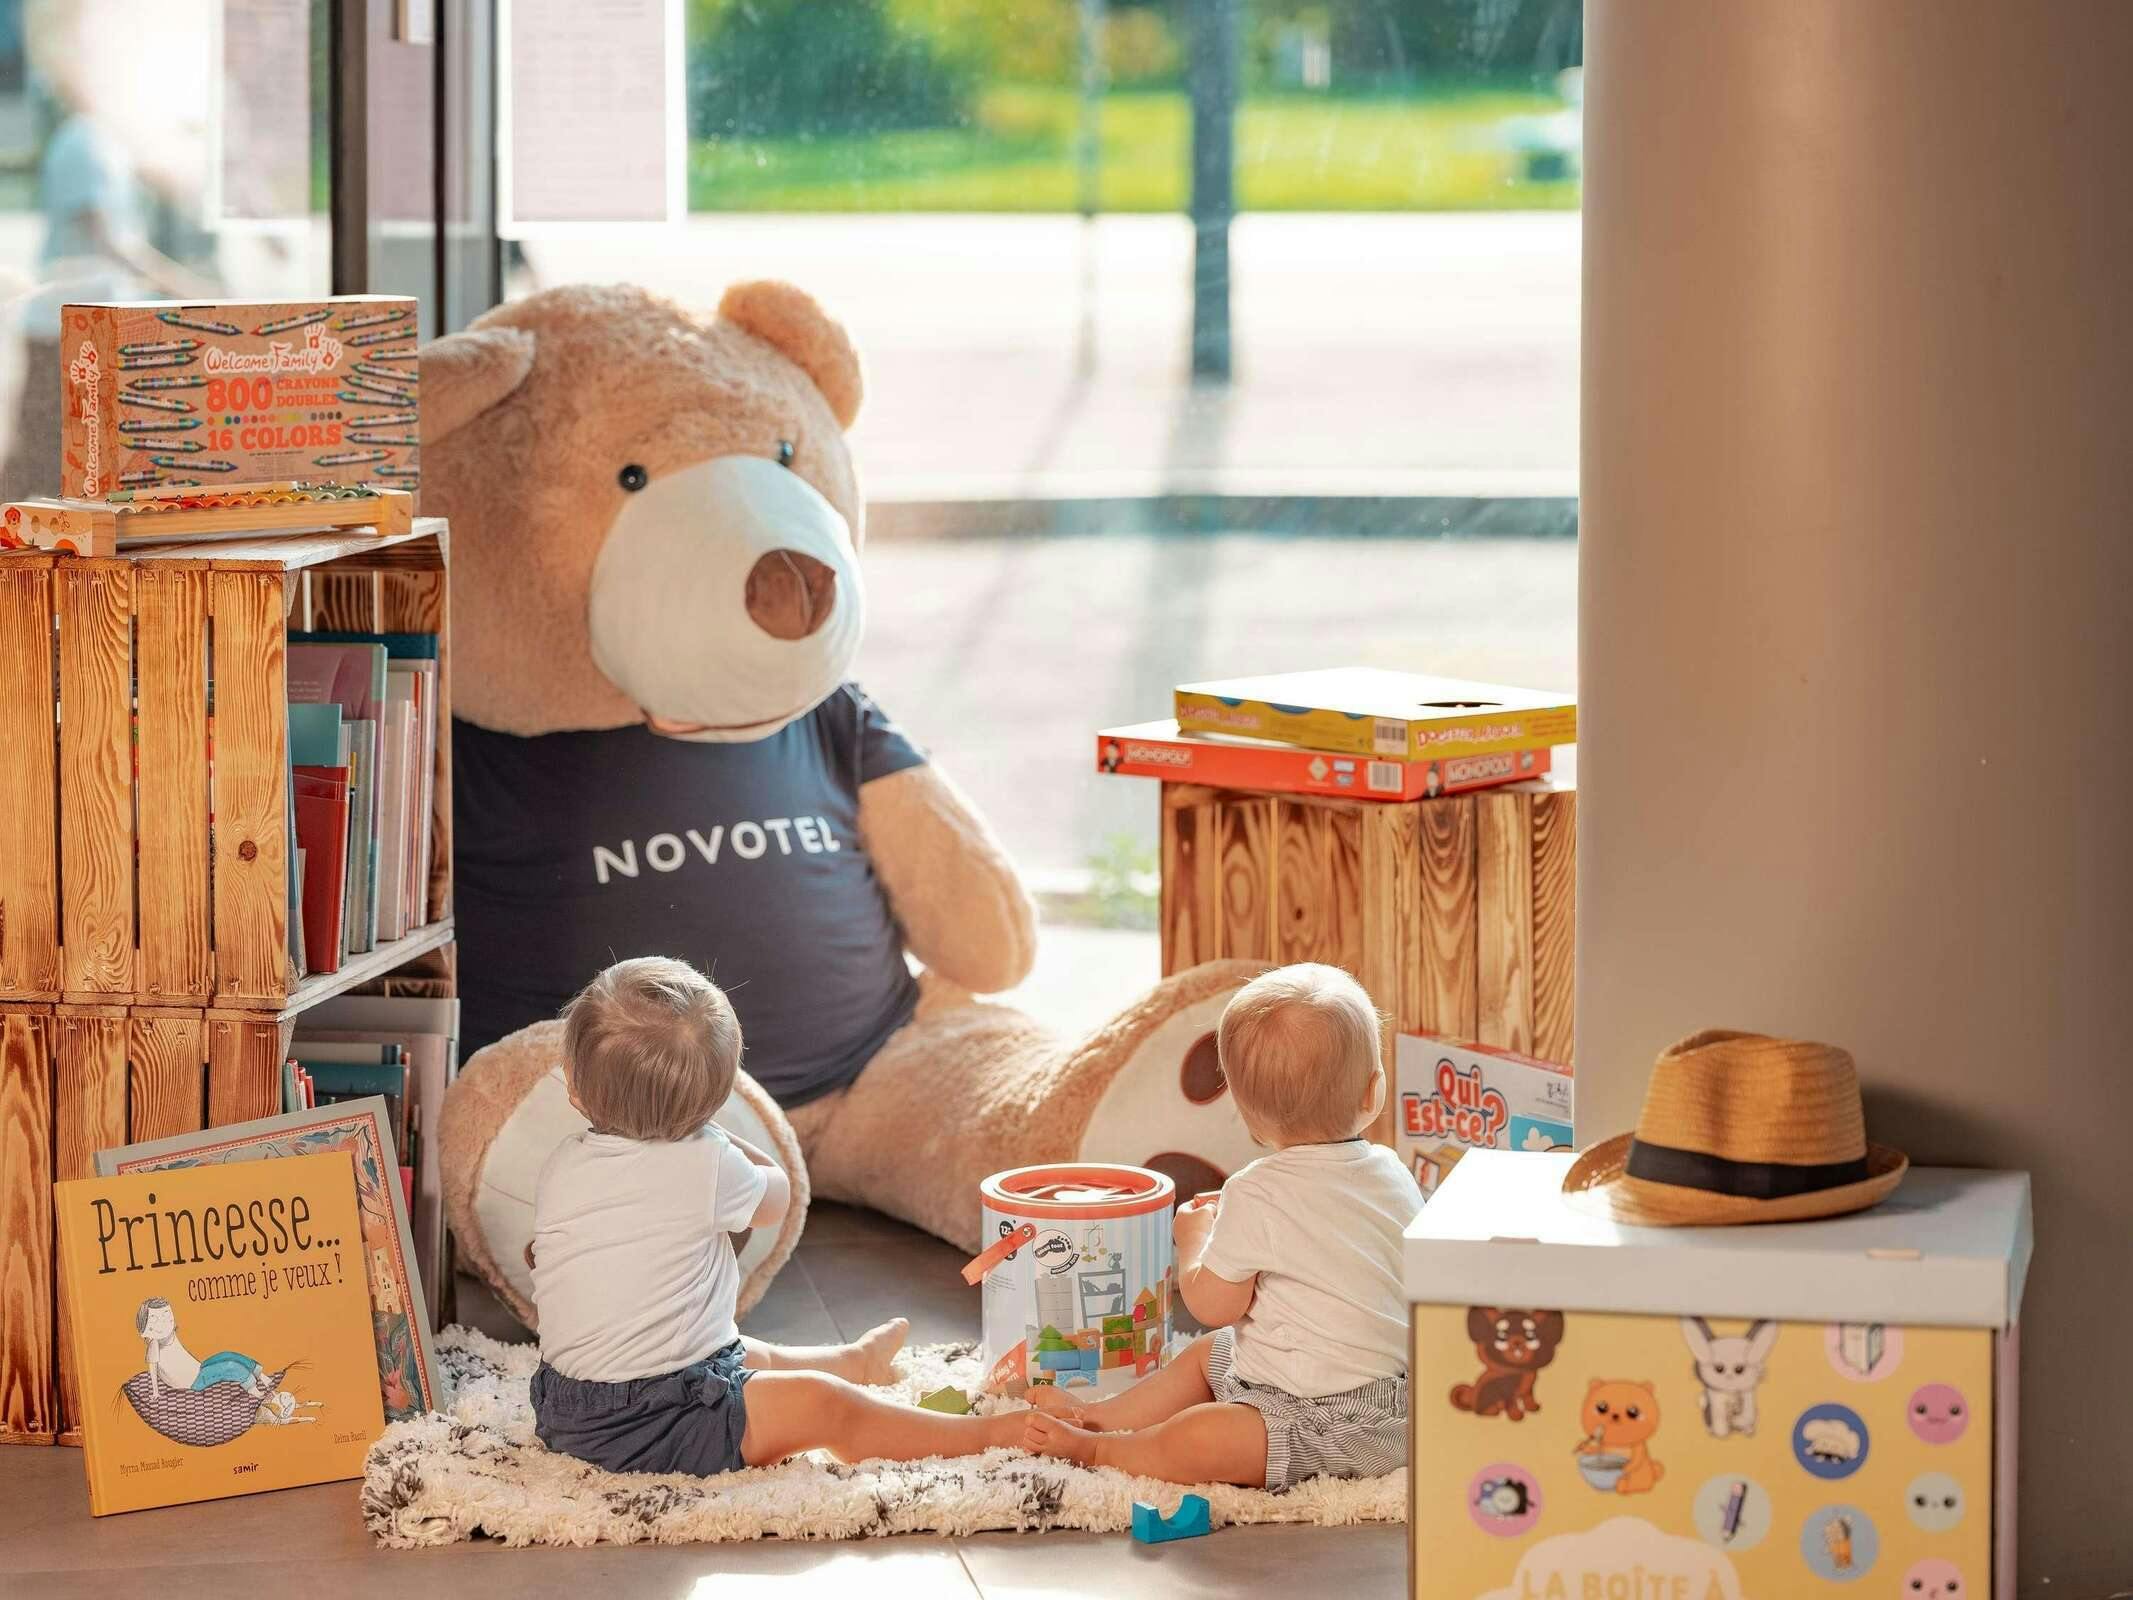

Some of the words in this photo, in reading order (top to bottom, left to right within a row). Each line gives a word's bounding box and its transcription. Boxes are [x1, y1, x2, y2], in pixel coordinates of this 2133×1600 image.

[206, 348, 268, 372] Welcome
[271, 344, 319, 373] Family
[82, 370, 99, 421] Family
[207, 376, 273, 413] 800
[276, 376, 341, 391] CRAYONS
[276, 392, 340, 408] DOUBLES
[207, 428, 234, 453] 16
[239, 422, 343, 451] COLORS
[85, 424, 98, 496] Welcome
[1126, 746, 1192, 768] MONOPOLY
[1448, 755, 1515, 784] MONOPOLY
[592, 815, 841, 884] NOVOTEL
[1436, 1061, 1482, 1110] Qui
[187, 1271, 257, 1302] comme
[262, 1260, 279, 1300] je
[283, 1261, 331, 1291] veux
[334, 1252, 344, 1285] !
[232, 1462, 259, 1475] samir
[1521, 1568, 1568, 1600] LA
[1582, 1561, 1690, 1600] BOÎTE
